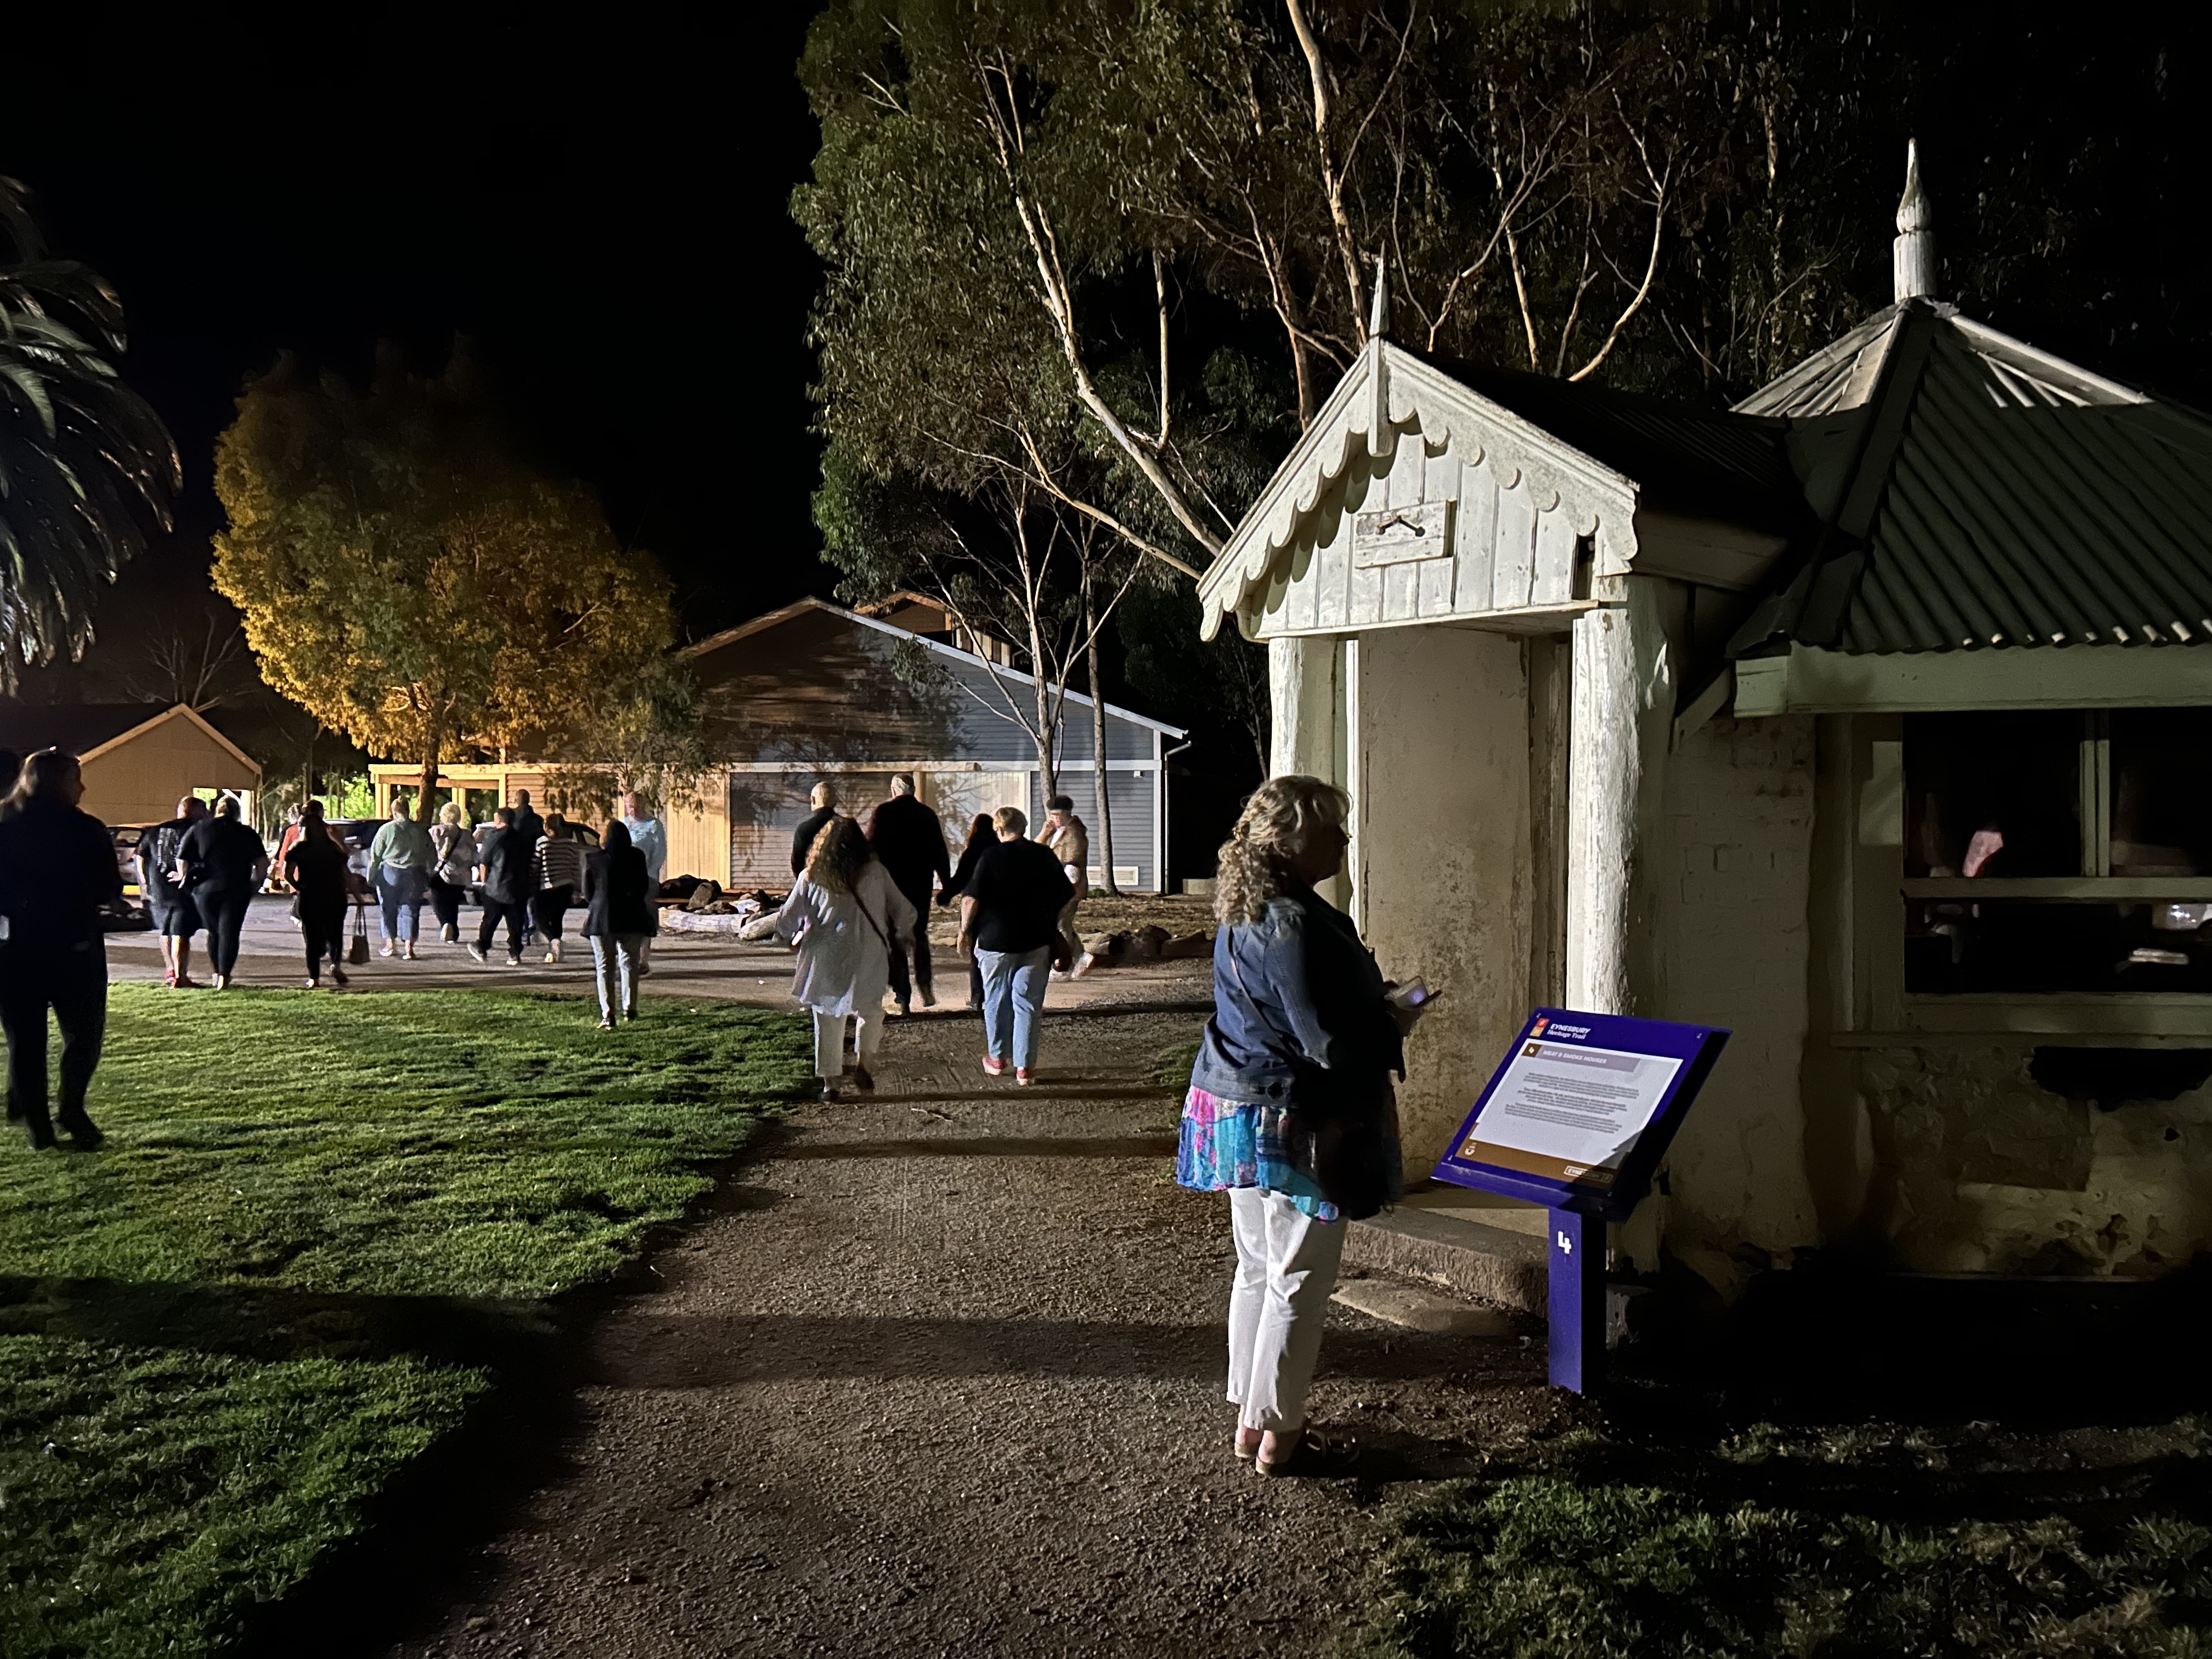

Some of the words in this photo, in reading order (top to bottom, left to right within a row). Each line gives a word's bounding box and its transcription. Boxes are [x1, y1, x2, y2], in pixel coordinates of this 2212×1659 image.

[1547, 1030, 1571, 1038] Heritage
[1550, 1024, 1591, 1034] EYNESBURY
[1558, 1231, 1572, 1254] 4
